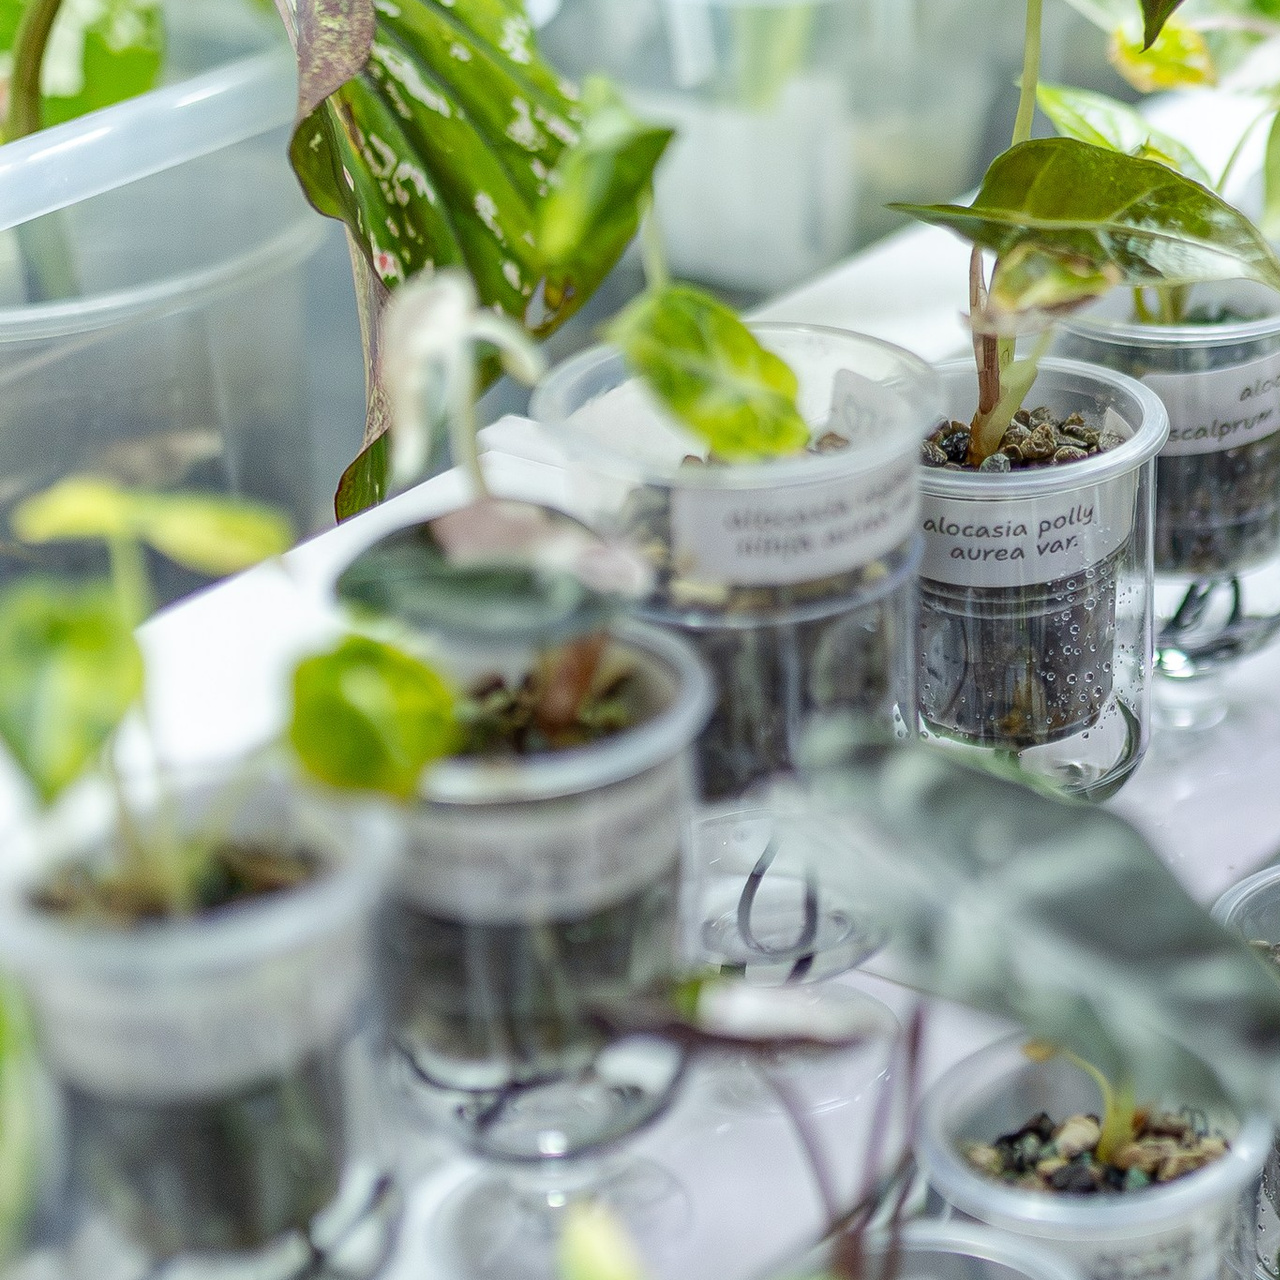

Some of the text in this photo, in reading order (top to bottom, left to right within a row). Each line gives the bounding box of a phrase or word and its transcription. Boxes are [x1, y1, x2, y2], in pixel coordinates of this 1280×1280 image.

[923, 505, 1095, 538] alocasia polly
[950, 534, 1079, 561] aurea var.
